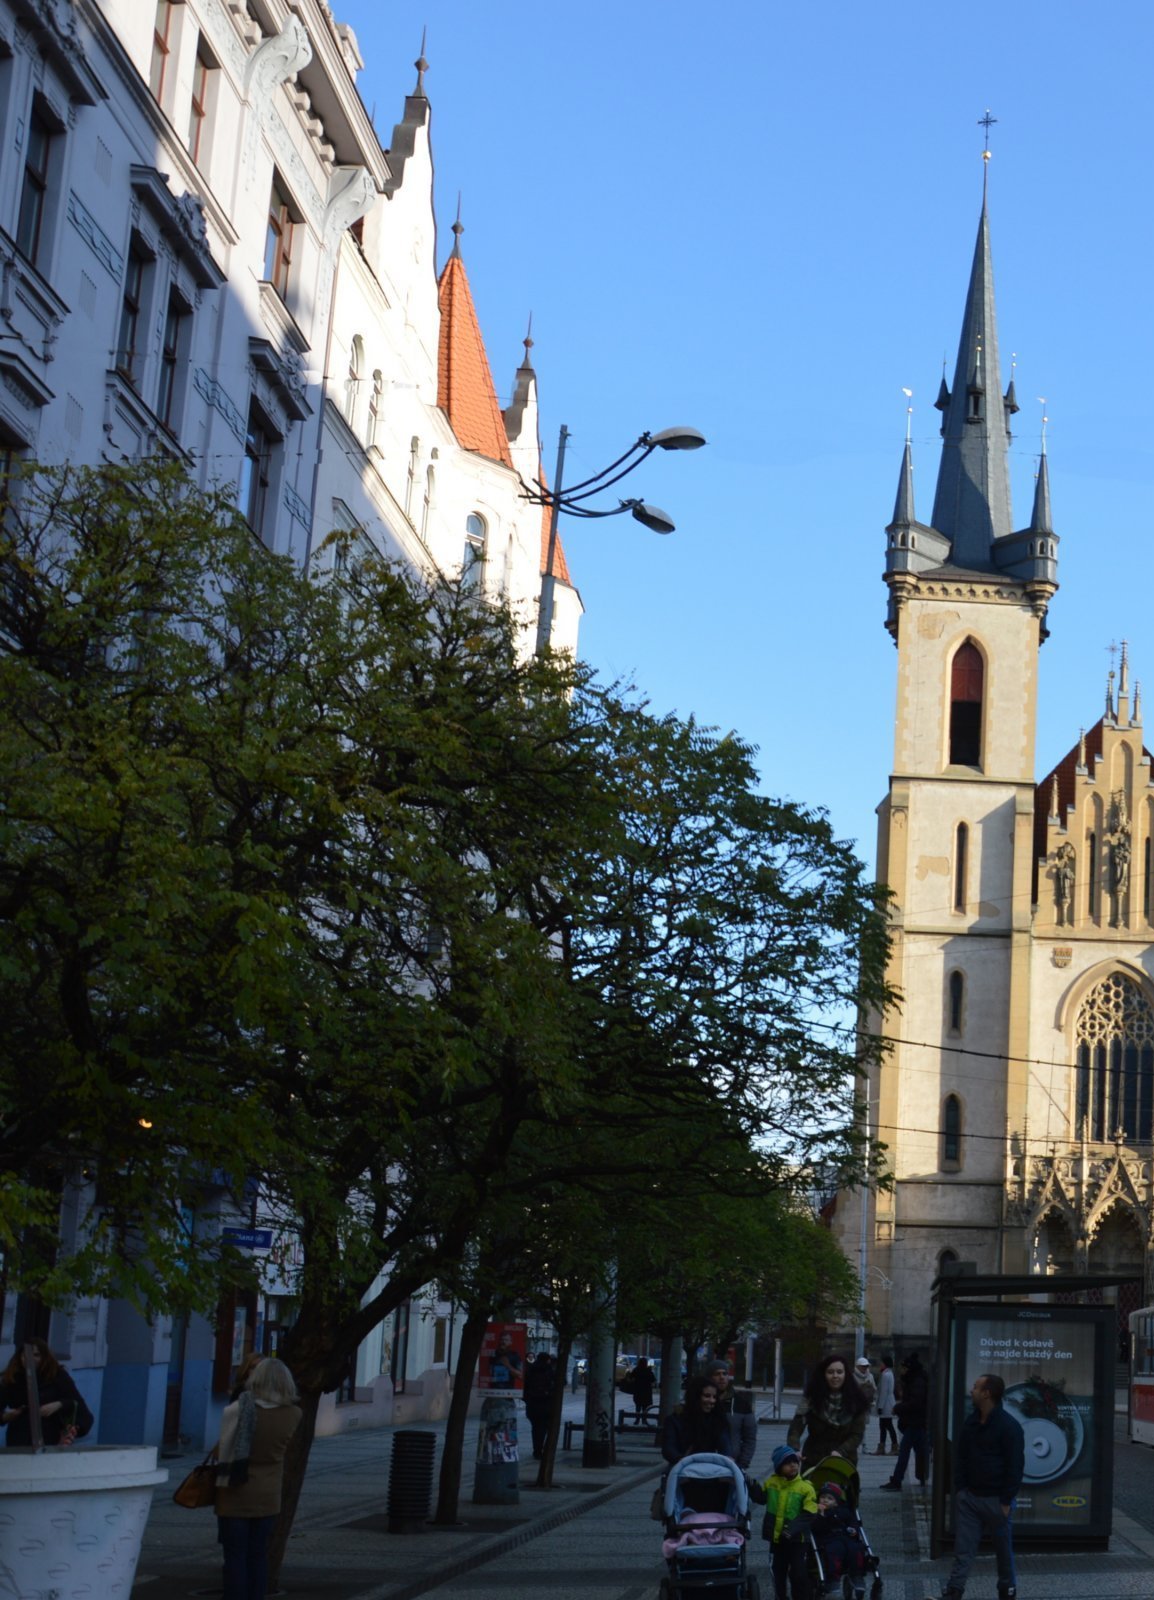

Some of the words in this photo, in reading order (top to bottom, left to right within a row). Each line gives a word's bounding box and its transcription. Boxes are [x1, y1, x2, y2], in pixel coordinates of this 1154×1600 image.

[979, 1337, 1011, 1347] Důvod
[1013, 1338, 1020, 1347] k
[1022, 1338, 1054, 1348] oslavě
[993, 1350, 1021, 1360] najde
[1023, 1349, 1051, 1360] každý
[1053, 1351, 1072, 1359] den
